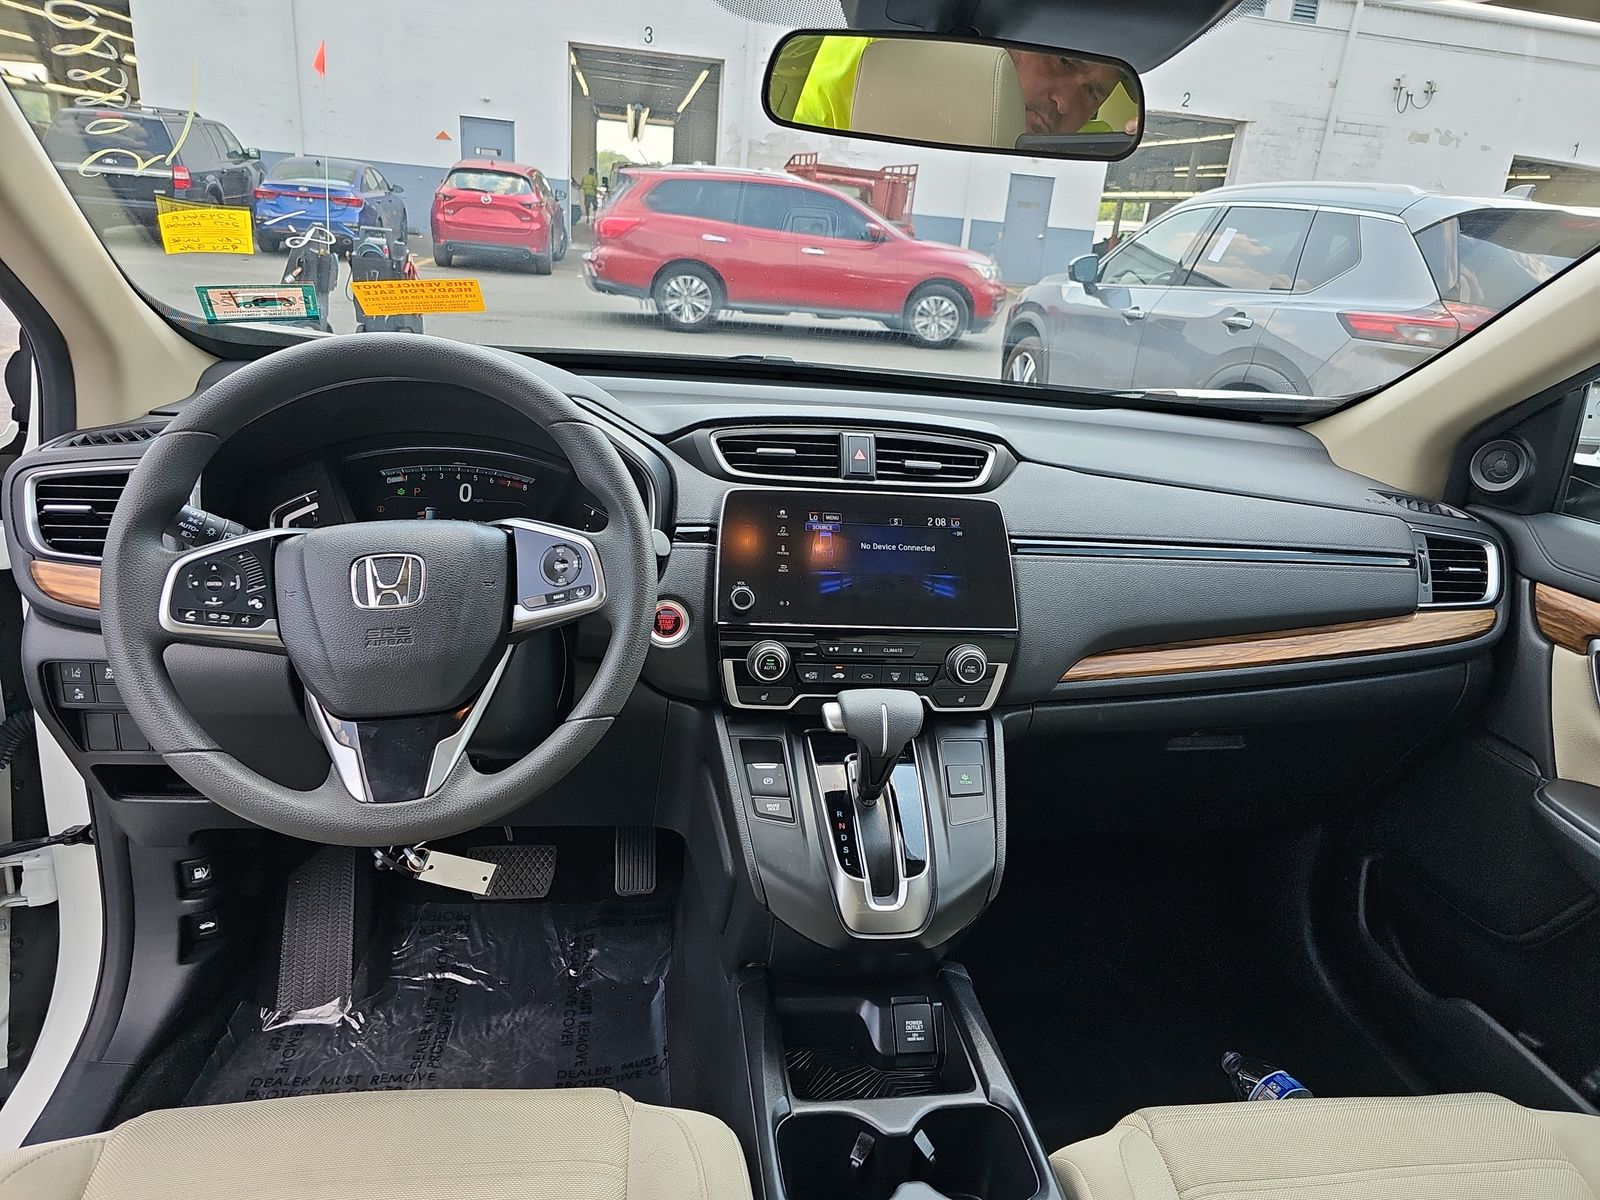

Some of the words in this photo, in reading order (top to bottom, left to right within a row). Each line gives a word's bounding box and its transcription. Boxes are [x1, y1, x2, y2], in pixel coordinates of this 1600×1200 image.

[644, 26, 653, 44] 3
[1181, 92, 1191, 108] 2
[1574, 141, 1580, 157] 1
[413, 487, 421, 497] P
[459, 483, 472, 503] 0
[808, 512, 818, 521] Lo
[178, 521, 196, 532] AUTO
[811, 523, 834, 531] SOURCE
[950, 519, 960, 527] Lo
[860, 542, 871, 550] No
[872, 542, 897, 551] Device
[897, 543, 936, 552] Connected
[836, 810, 843, 818] R
[838, 822, 846, 830] N
[842, 846, 849, 854] S
[845, 858, 851, 866] L
[561, 1009, 577, 1047] COVER
[574, 1021, 591, 1068] REMOVE
[557, 1066, 612, 1079] DEALER
[621, 1054, 658, 1071] MUST
[250, 1075, 312, 1088] DEALER
[319, 1074, 363, 1086] MUST
[369, 1071, 437, 1086] REMOVE
